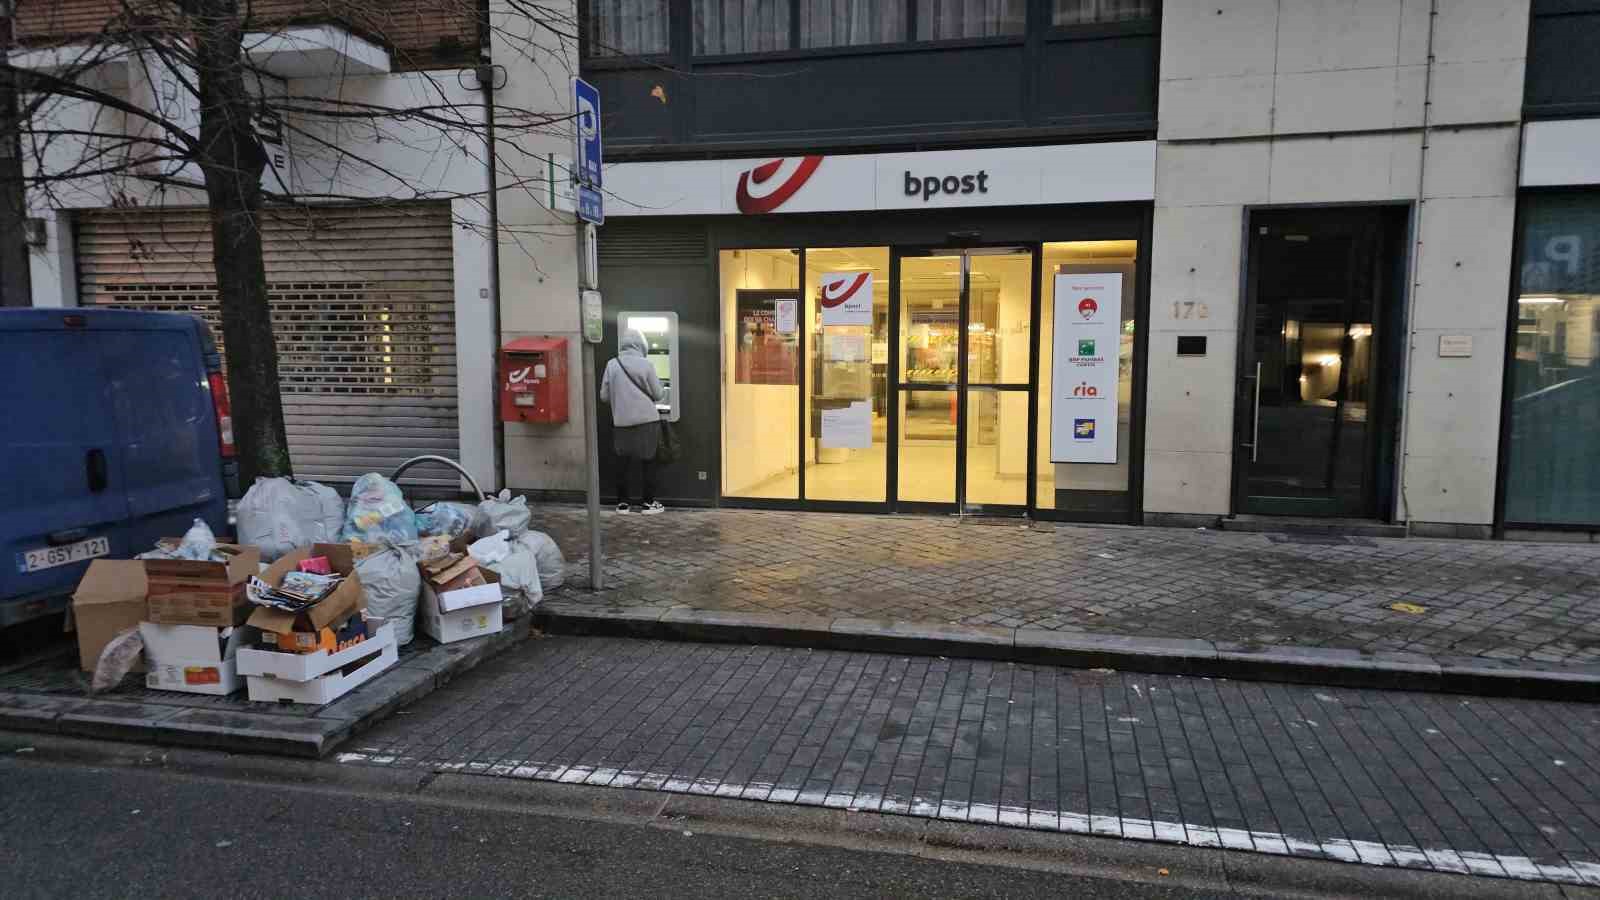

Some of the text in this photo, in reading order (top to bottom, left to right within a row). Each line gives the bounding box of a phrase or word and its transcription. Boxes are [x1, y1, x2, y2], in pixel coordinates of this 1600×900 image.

[578, 95, 597, 171] P
[904, 169, 989, 202] bpost
[1074, 381, 1097, 396] ria
[28, 538, 108, 569] 2-GSY-121
